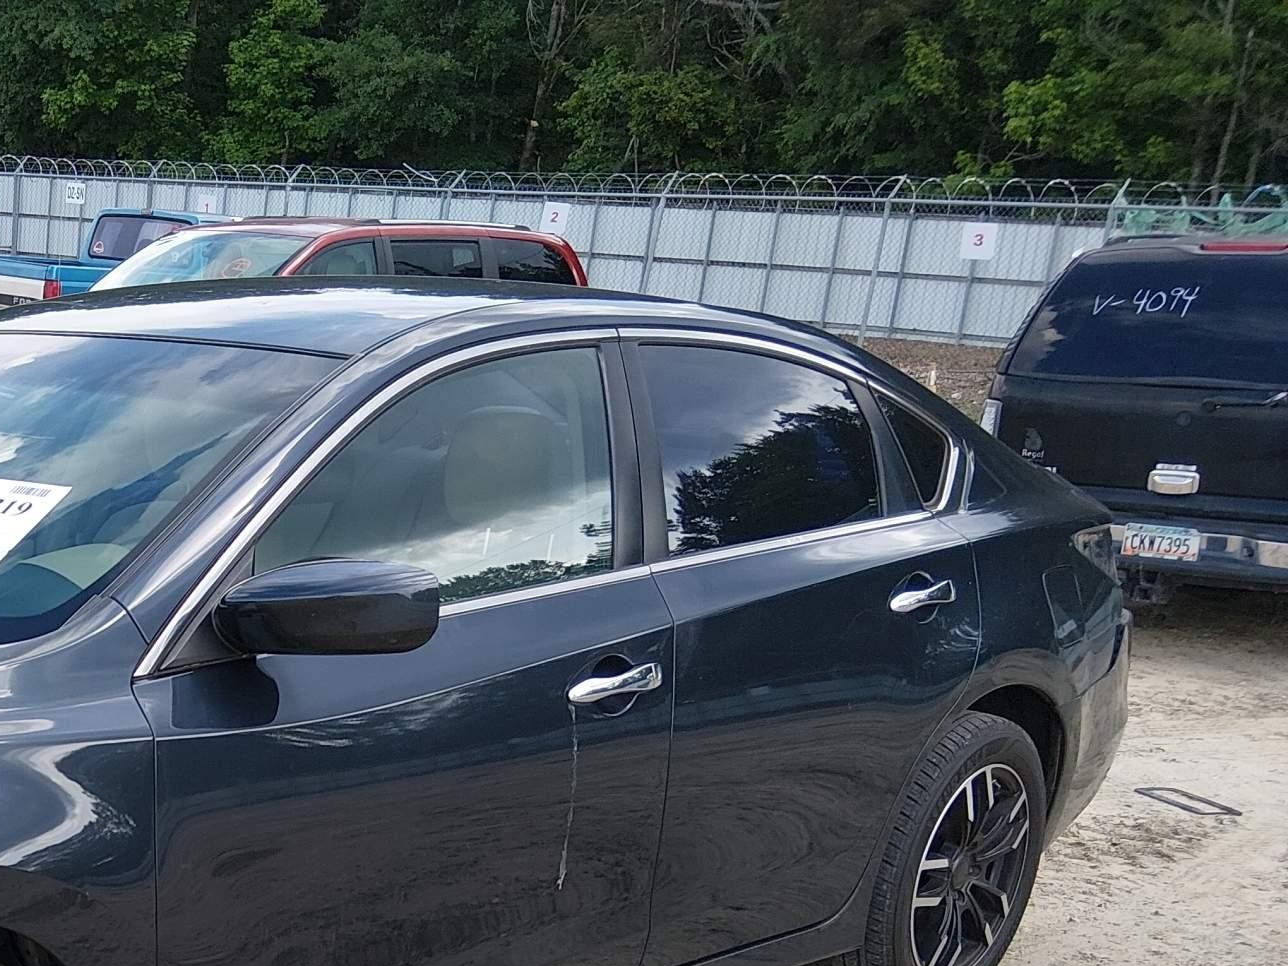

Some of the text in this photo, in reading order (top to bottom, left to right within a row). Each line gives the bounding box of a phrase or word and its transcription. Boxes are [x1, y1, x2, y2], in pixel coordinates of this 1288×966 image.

[550, 211, 559, 223] 2
[973, 233, 984, 247] 3
[1130, 533, 1191, 555] CKW7395
